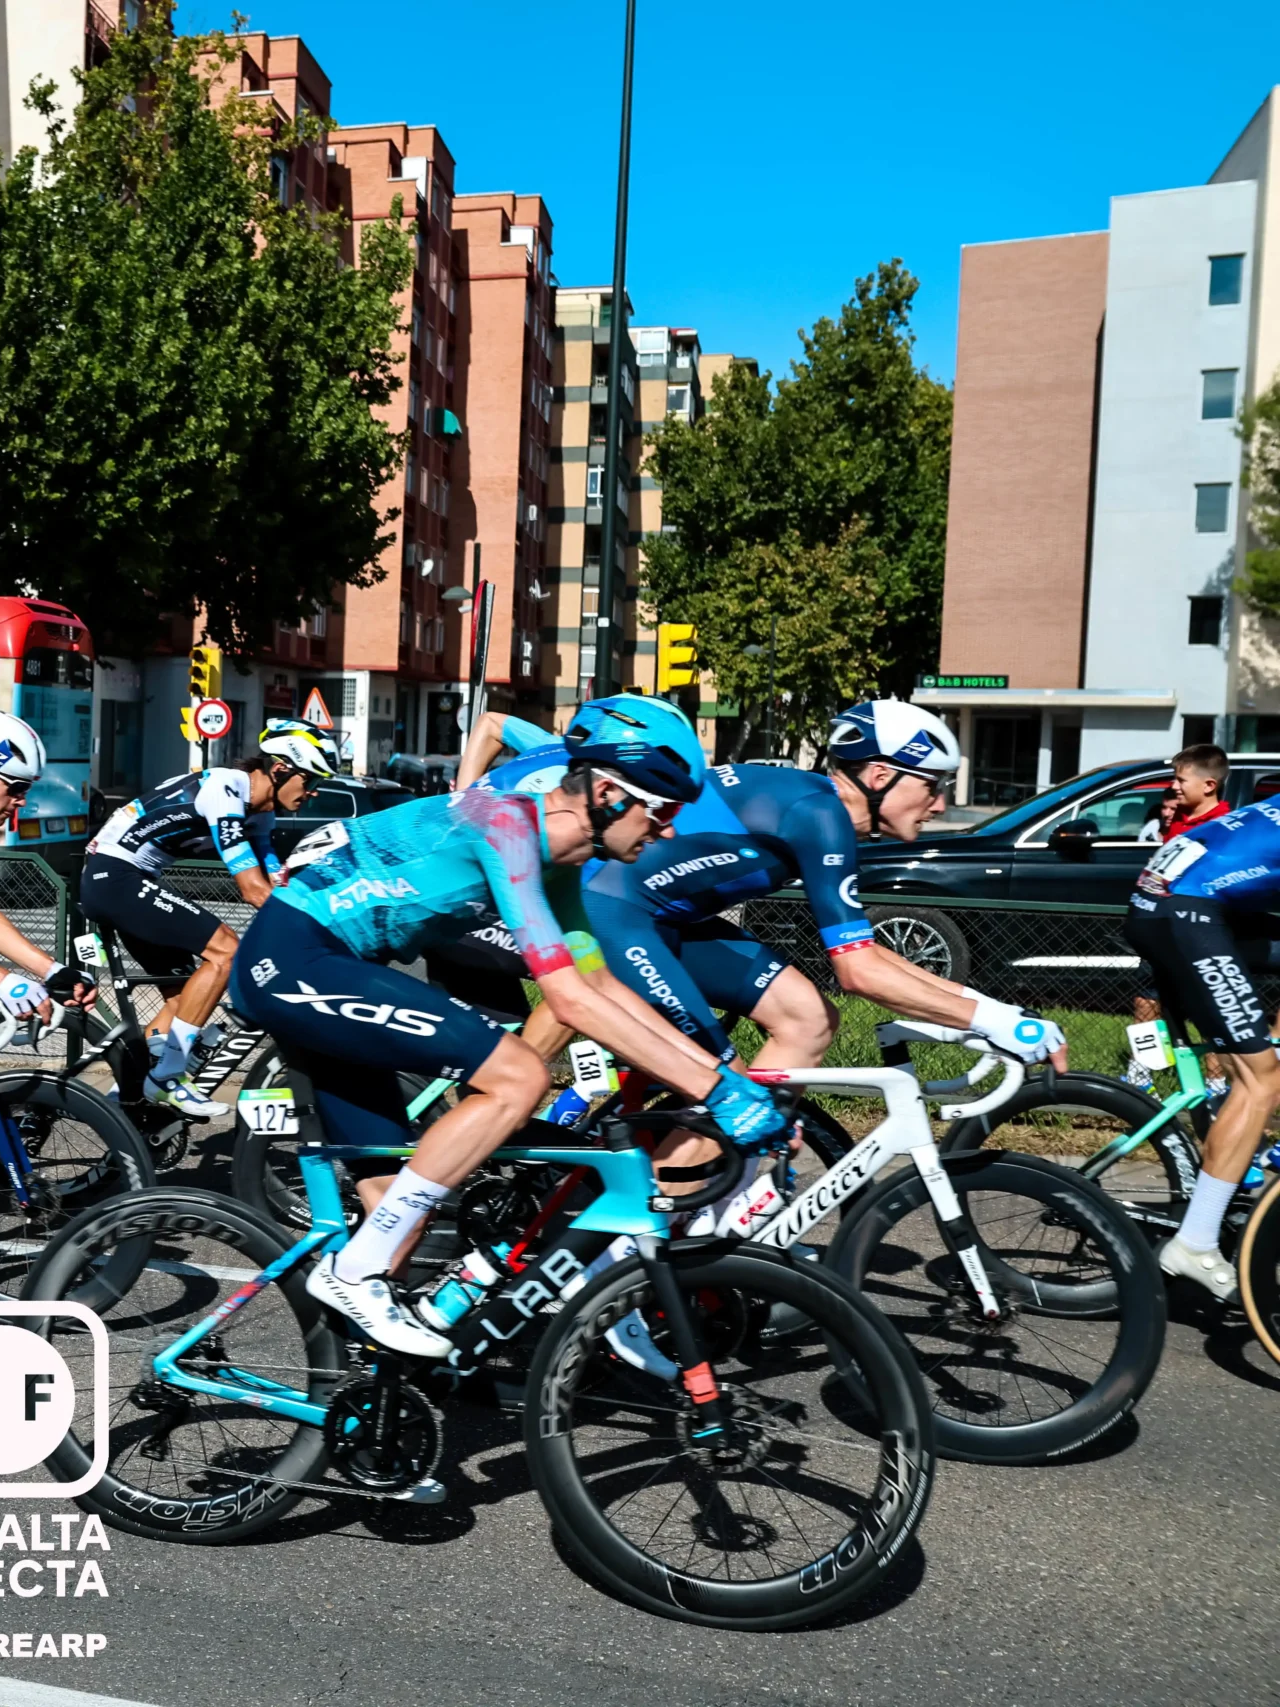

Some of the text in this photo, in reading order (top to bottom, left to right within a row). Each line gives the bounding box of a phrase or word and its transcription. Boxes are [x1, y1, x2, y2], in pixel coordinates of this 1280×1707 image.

[938, 677, 1005, 688] B&B HOTELS
[167, 811, 193, 826] Tech
[644, 851, 739, 890] FDJ UNITED
[152, 896, 174, 913] Tech
[78, 943, 96, 961] 38
[624, 945, 698, 1036] Groupama
[1193, 957, 1255, 1042] MONDIALE
[1213, 955, 1263, 1021] AG2R LA
[1135, 1033, 1158, 1053] 91
[576, 1049, 603, 1083] 138
[253, 1104, 289, 1132] 127
[758, 1144, 881, 1248] Wilier
